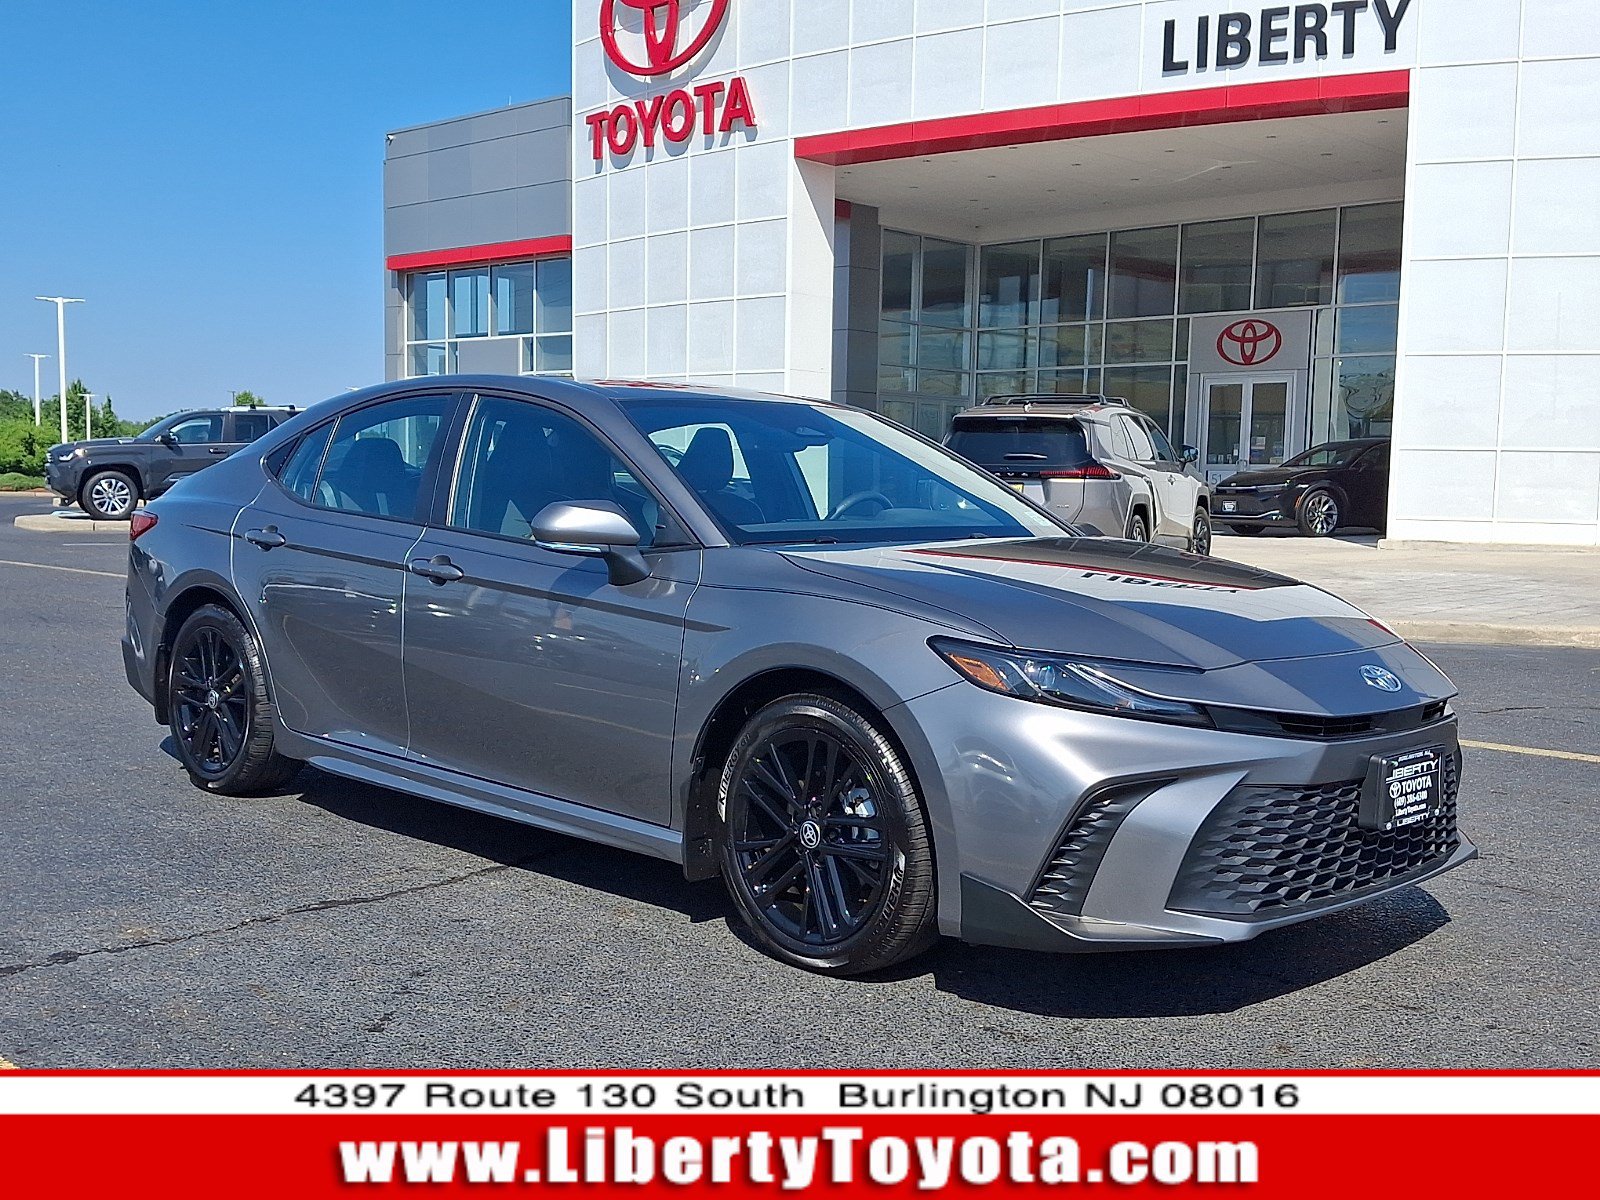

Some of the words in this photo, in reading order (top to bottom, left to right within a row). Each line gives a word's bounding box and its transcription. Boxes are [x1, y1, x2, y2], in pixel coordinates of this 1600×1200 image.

[1162, 0, 1410, 73] LIBERTY
[586, 77, 757, 160] TOYOTA
[1386, 759, 1438, 781] LIBERTY
[1402, 775, 1432, 794] TOYOTA
[1397, 812, 1430, 827] LIBERTY
